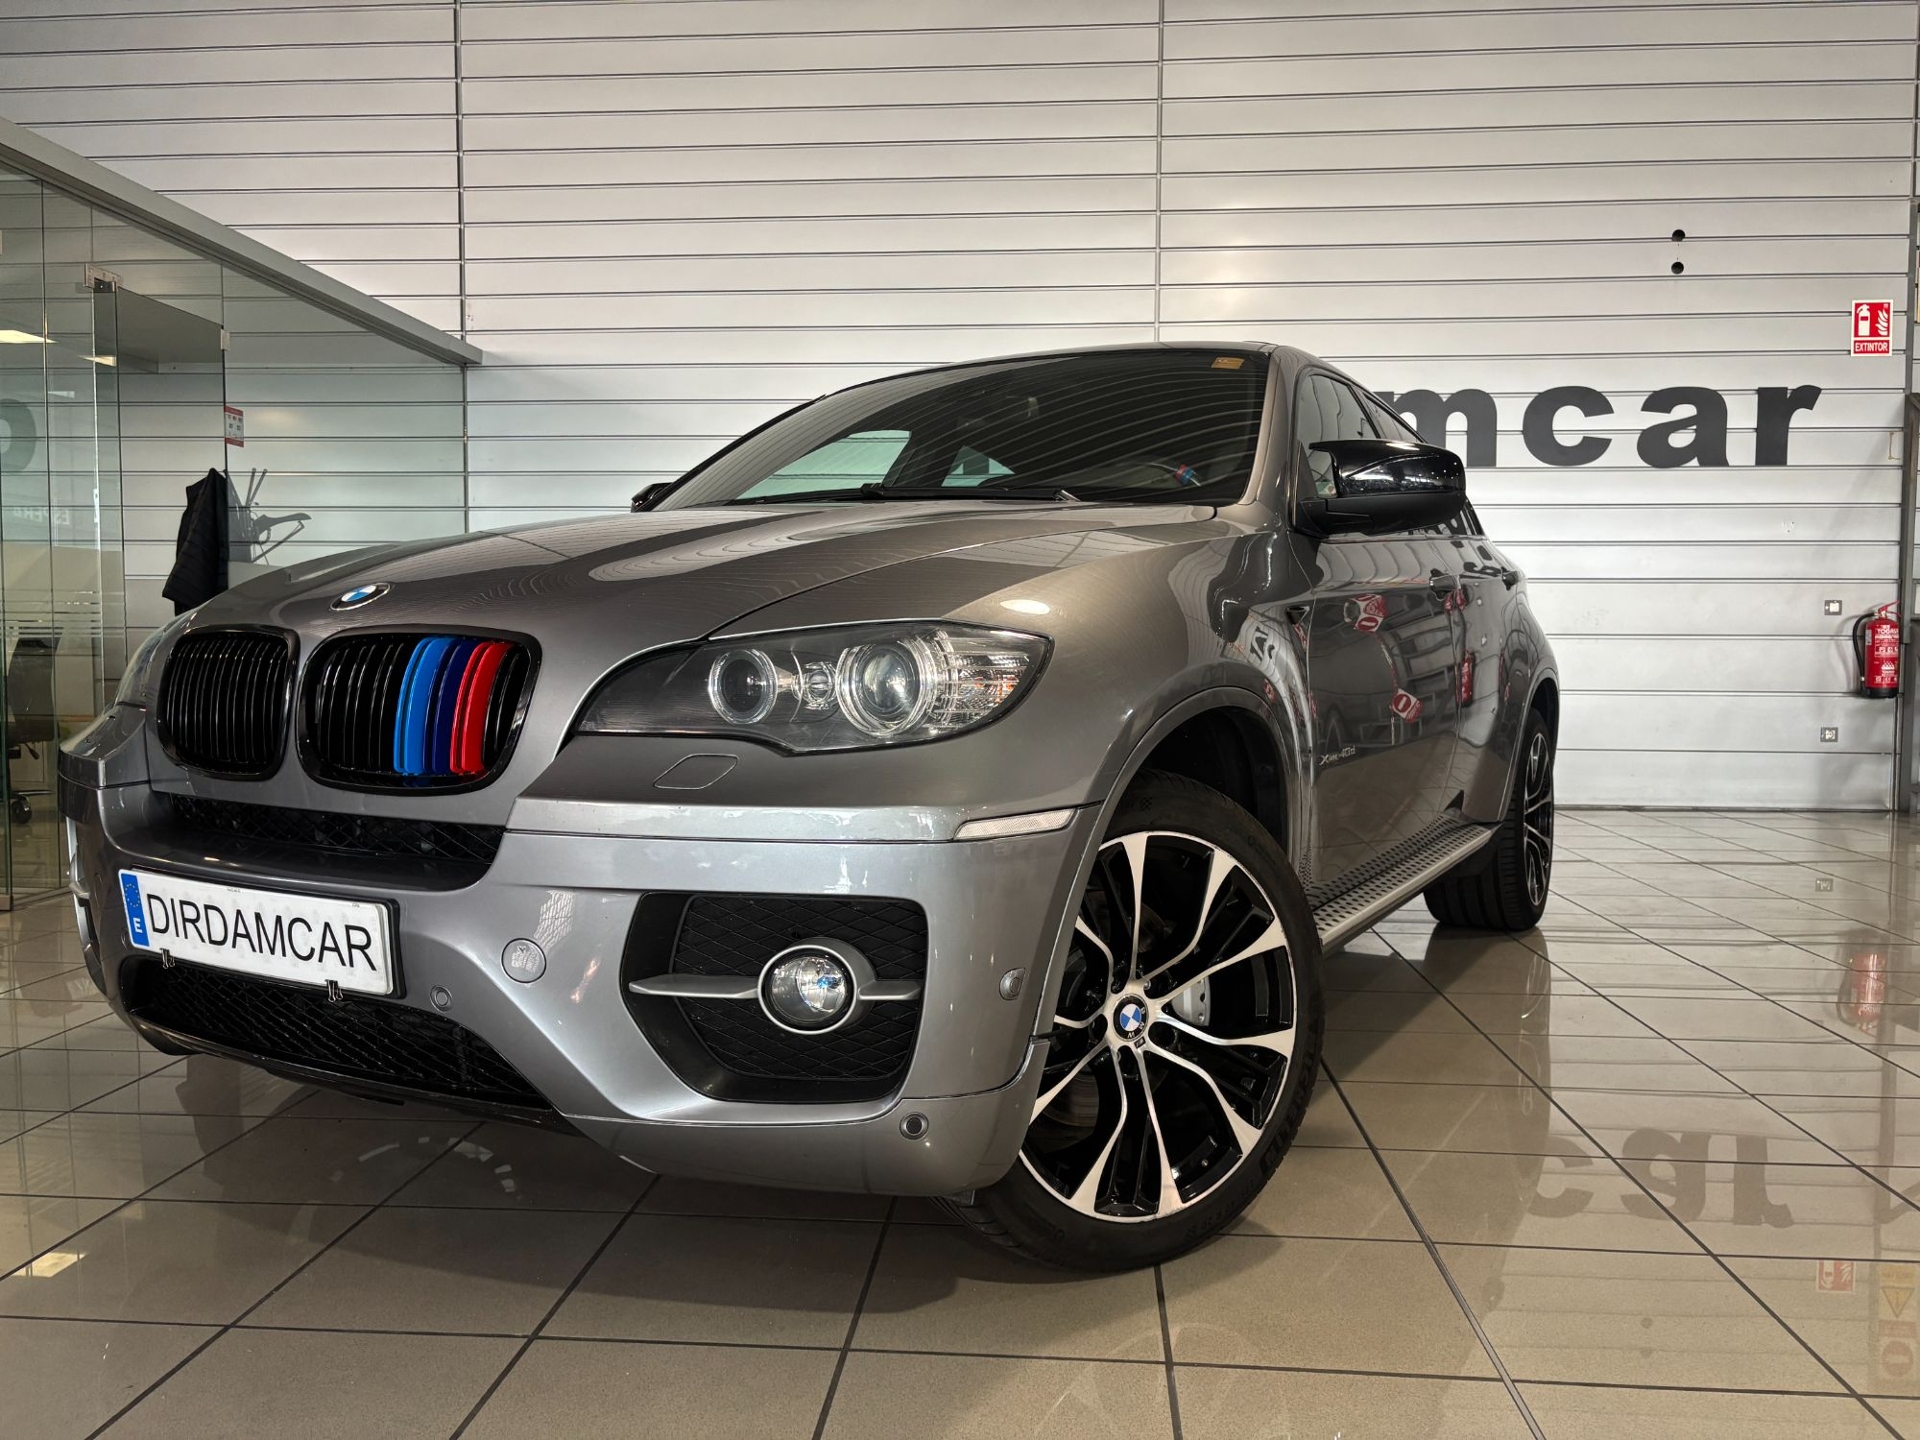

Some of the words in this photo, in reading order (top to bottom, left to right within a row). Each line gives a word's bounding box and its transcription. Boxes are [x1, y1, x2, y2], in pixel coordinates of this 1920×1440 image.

[1855, 341, 1888, 352] EXTINTOR
[133, 917, 143, 933] E
[146, 893, 378, 972] DIRDAMCAR
